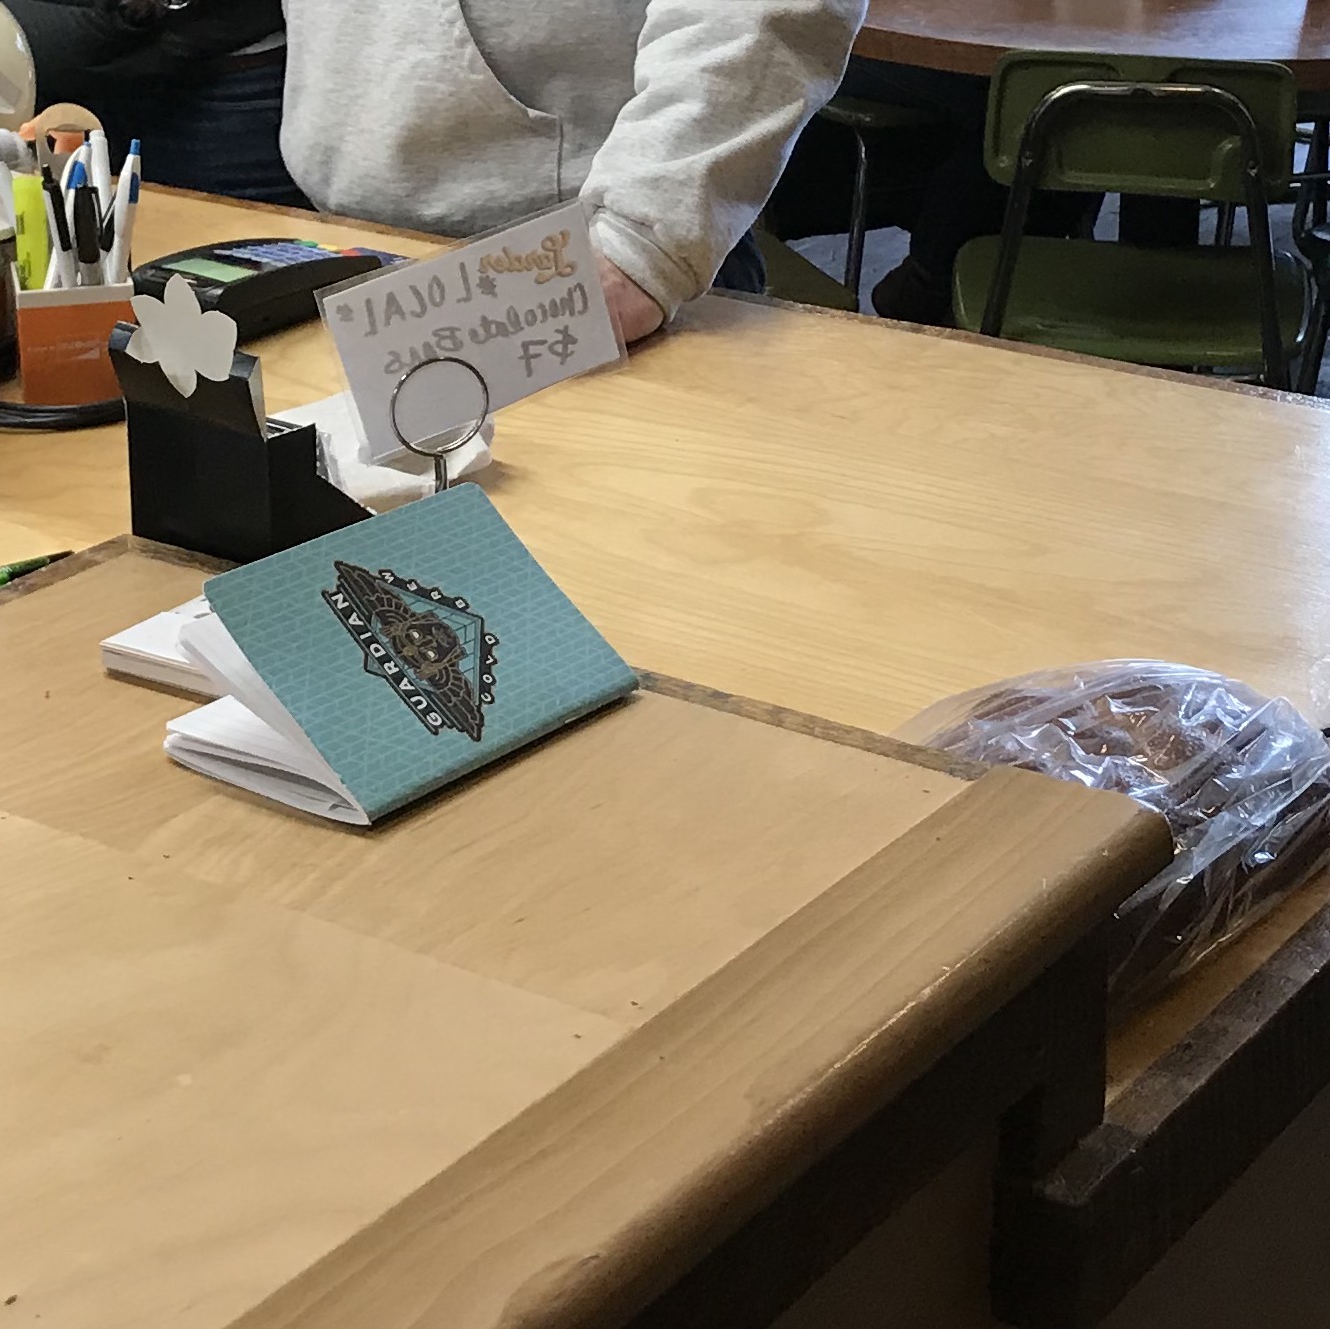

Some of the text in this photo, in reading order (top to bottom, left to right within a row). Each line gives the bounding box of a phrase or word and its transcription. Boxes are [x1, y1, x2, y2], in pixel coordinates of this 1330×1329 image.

[330, 592, 443, 727] GUARDIAN
[380, 571, 497, 703] COLD BREW
